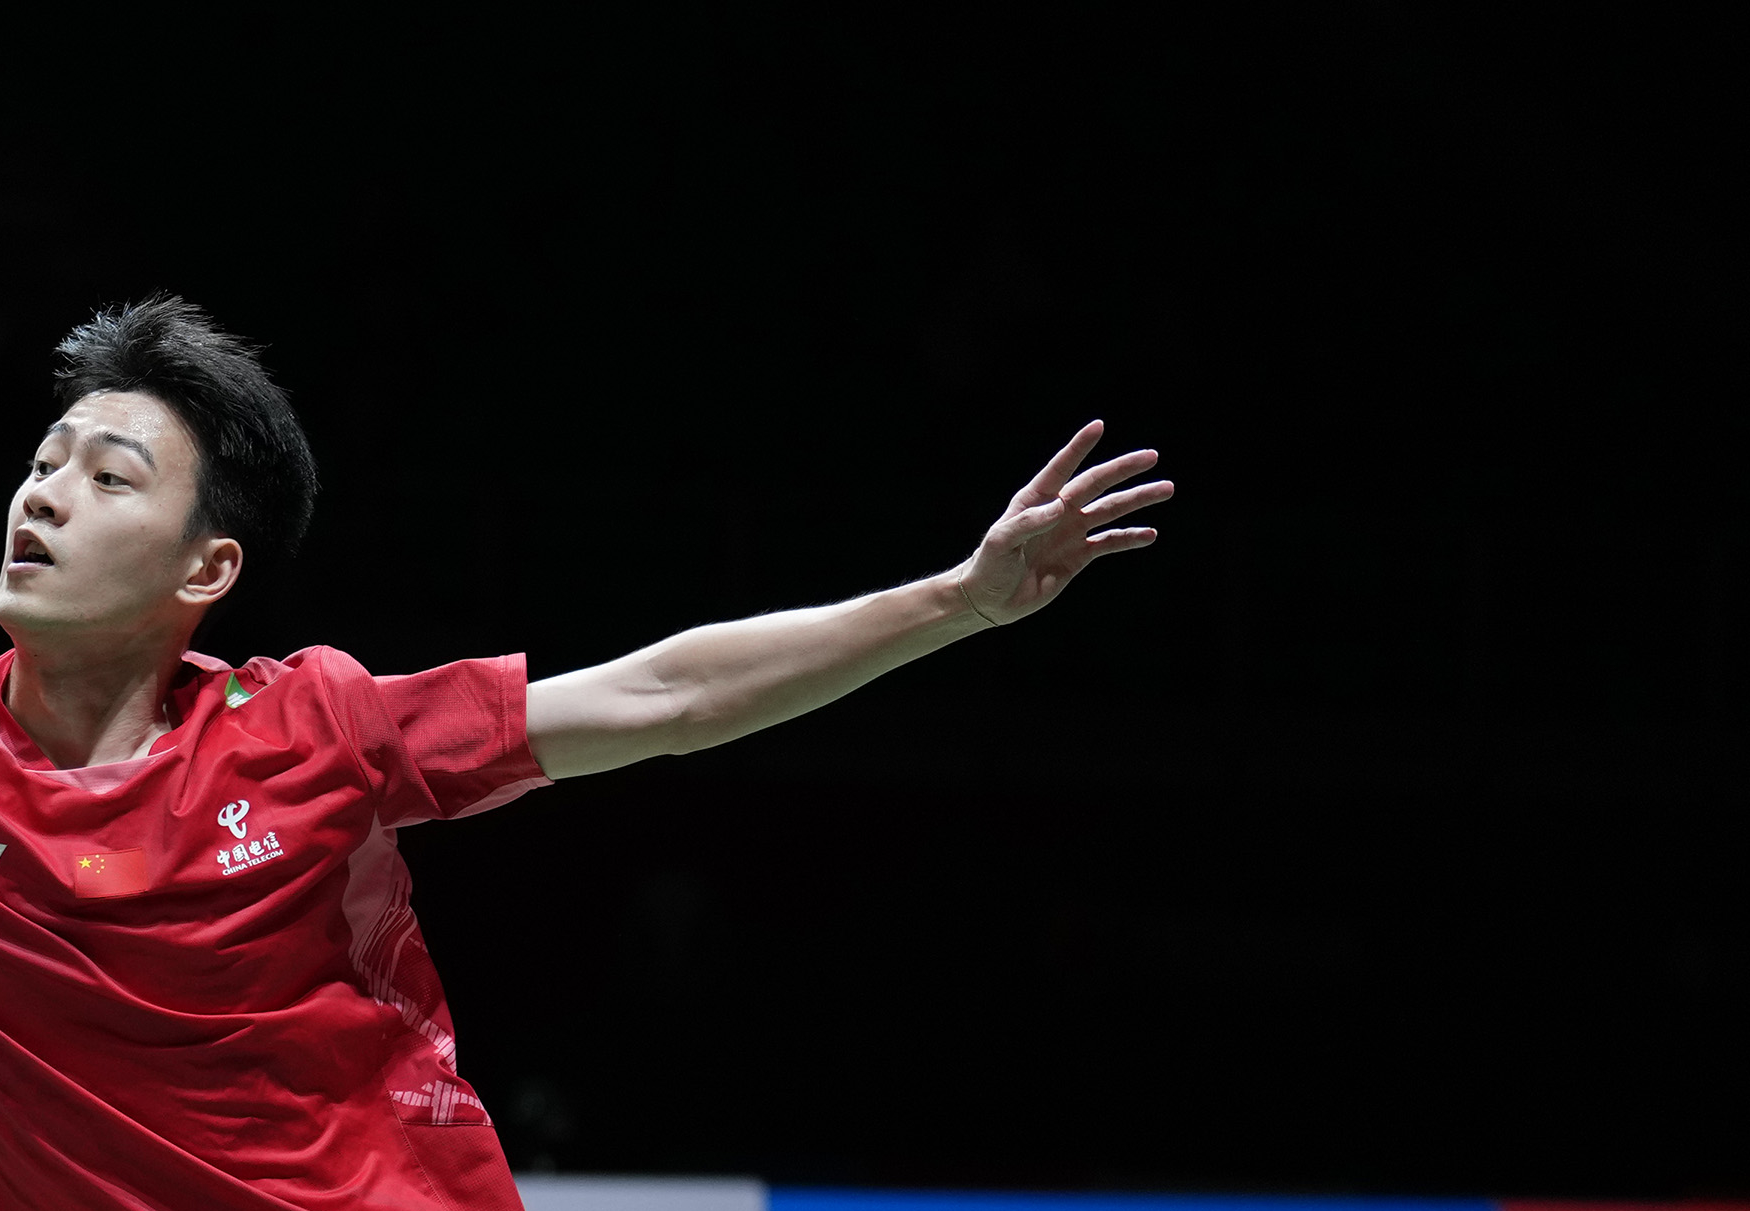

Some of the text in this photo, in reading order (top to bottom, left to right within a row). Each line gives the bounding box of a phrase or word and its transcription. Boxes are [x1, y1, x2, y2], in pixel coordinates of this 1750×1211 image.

[216, 831, 280, 868] 中国电信
[222, 849, 284, 876] CHINA TELECOM
